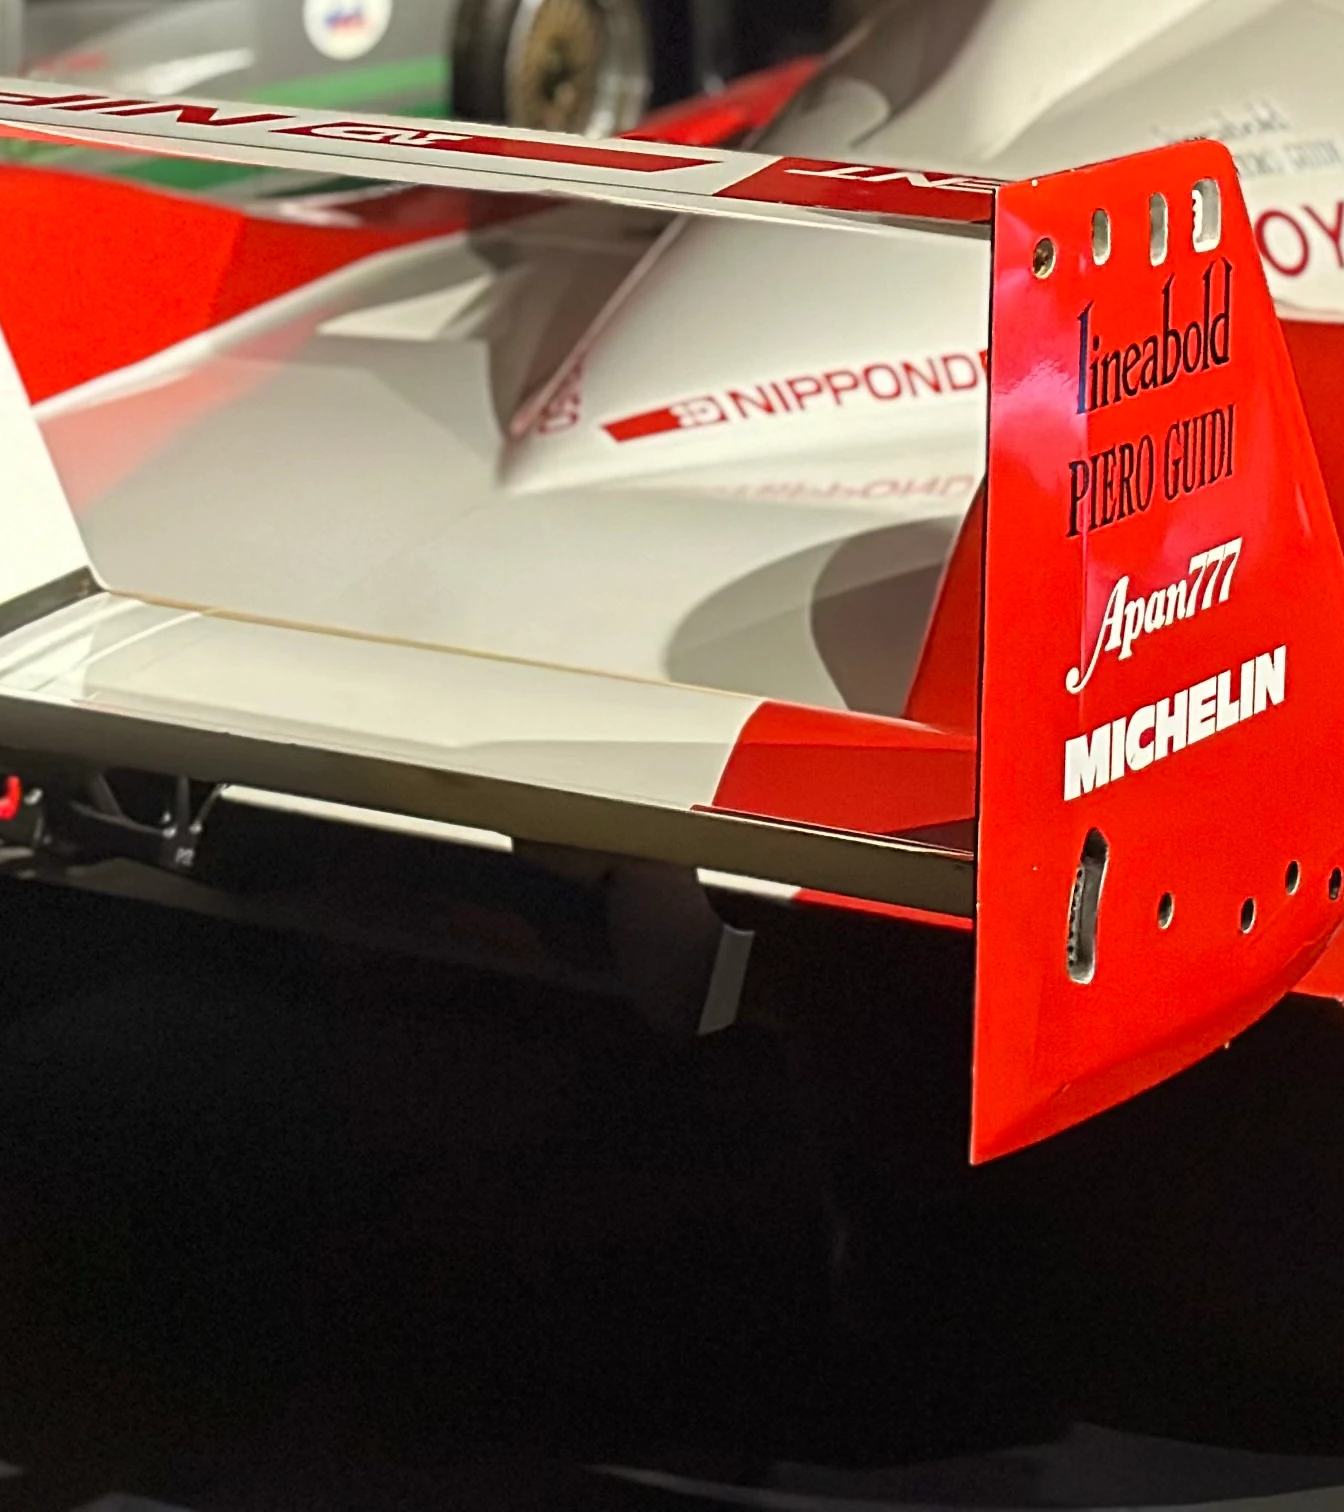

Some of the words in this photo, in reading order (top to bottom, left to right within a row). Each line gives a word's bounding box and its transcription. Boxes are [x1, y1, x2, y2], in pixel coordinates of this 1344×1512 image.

[783, 166, 1006, 195] ENT
[723, 349, 988, 420] NIPPOND
[1076, 256, 1233, 415] lineabold
[1065, 434, 1155, 539] PIERO
[1163, 403, 1235, 501] GUIDI
[1065, 536, 1243, 694] Apan777
[1063, 644, 1287, 802] MICHELIN
